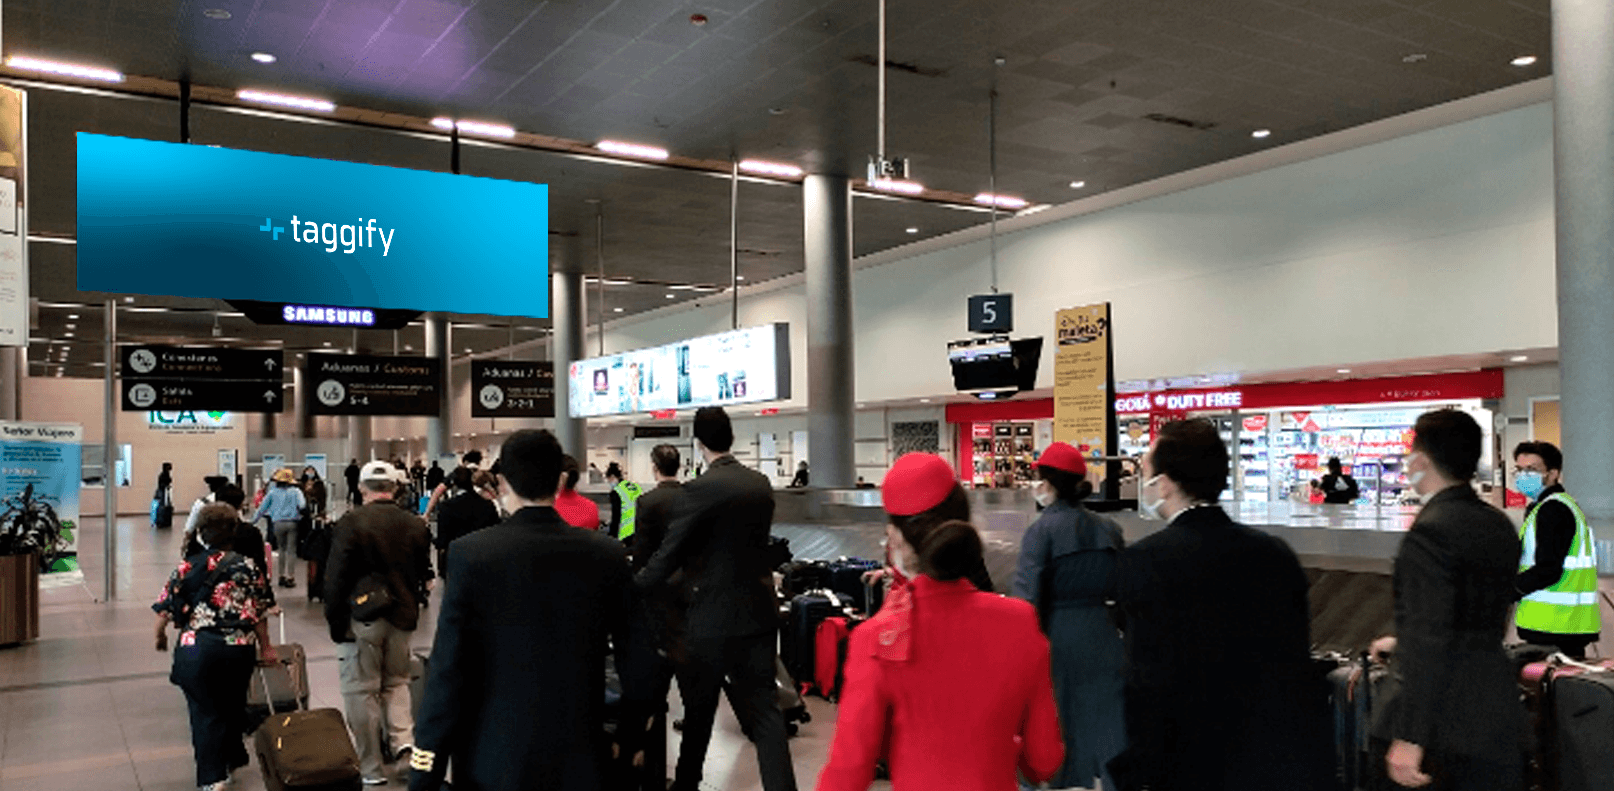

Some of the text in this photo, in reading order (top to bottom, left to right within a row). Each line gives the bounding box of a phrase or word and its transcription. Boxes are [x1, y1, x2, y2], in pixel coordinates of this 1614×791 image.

[291, 215, 395, 256] taggify
[283, 305, 375, 324] SAMSUNG
[982, 301, 996, 323] 5
[320, 361, 370, 373] Aduanas
[482, 367, 525, 378] Aduanas
[1167, 394, 1205, 410] DUTY
[1206, 391, 1243, 407] FREE
[3, 426, 76, 440] Señor Viajero
